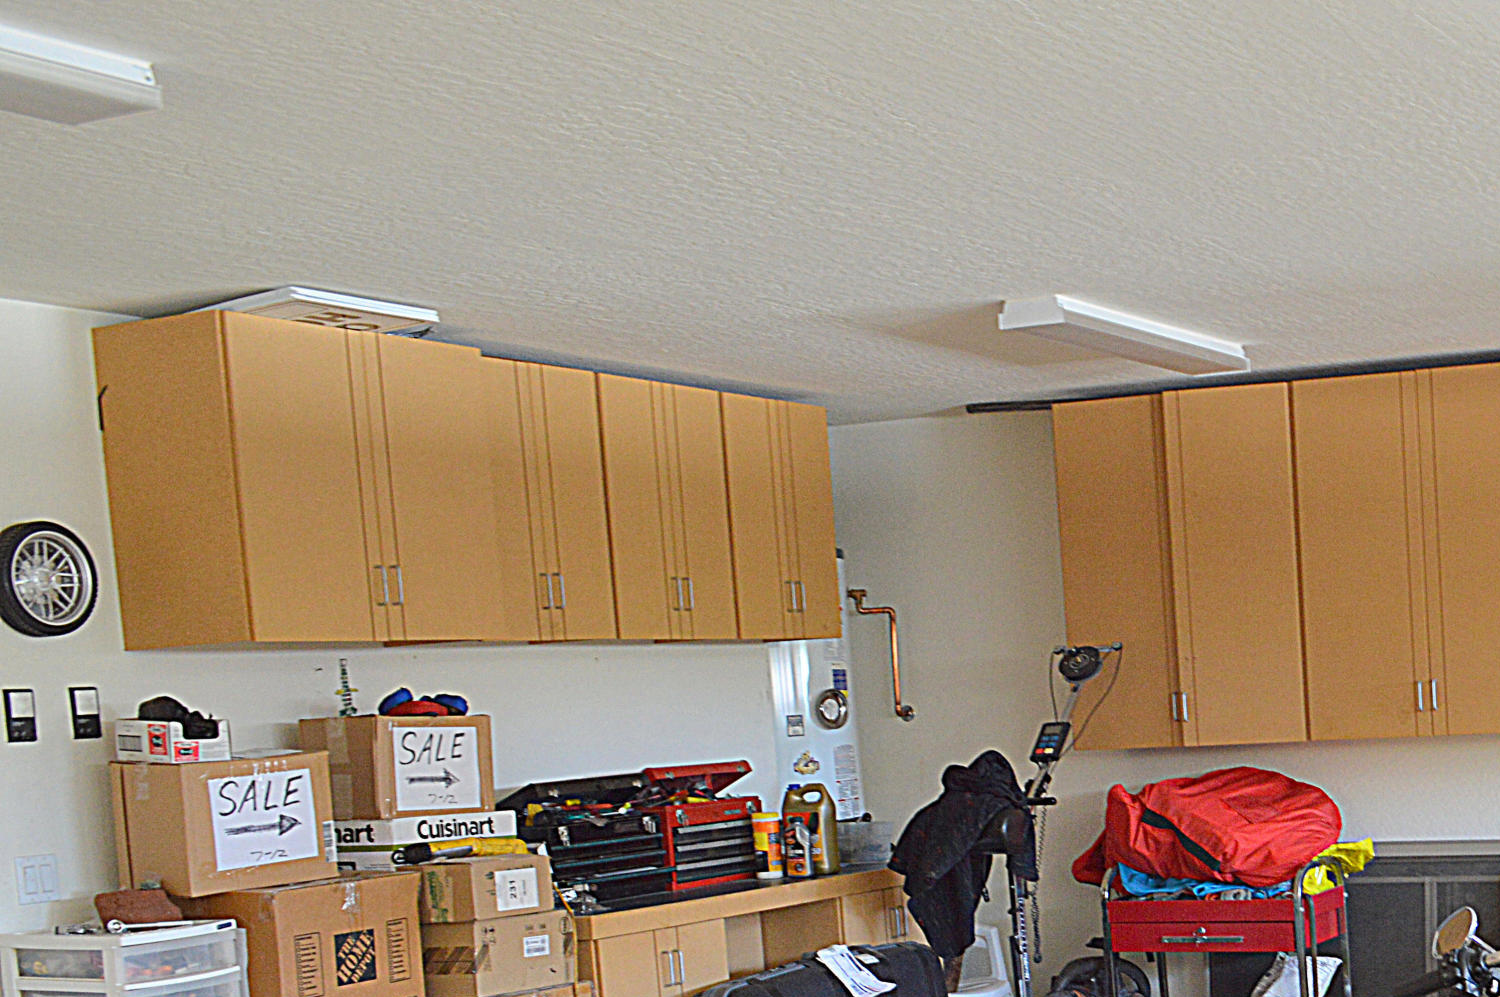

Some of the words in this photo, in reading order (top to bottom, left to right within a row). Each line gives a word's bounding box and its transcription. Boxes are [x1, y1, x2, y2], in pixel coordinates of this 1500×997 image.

[399, 731, 465, 765] SALE
[218, 775, 303, 816] SALE
[416, 816, 495, 840] Cuisinart
[337, 931, 373, 983] HOME
[338, 935, 355, 959] THE
[351, 946, 375, 983] DEPOT
